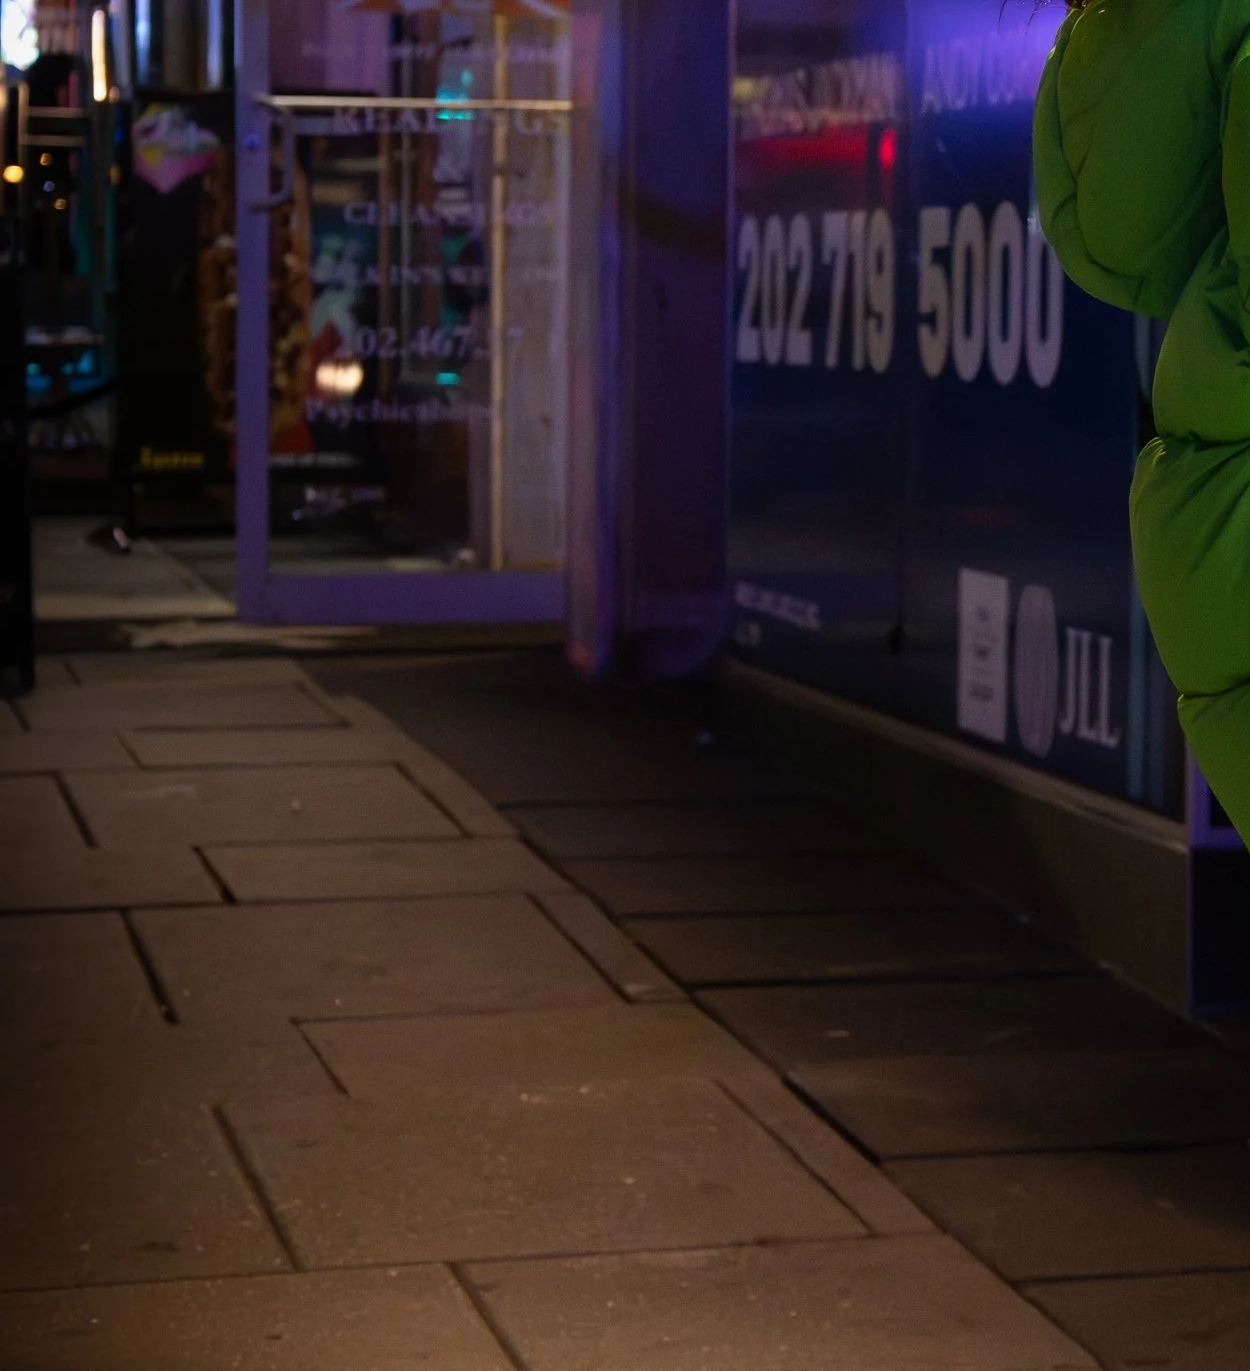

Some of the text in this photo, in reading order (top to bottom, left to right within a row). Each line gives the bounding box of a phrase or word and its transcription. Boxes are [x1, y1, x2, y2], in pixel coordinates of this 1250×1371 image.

[737, 200, 1065, 390] 202 719 5000
[1058, 627, 1121, 750] JLL
